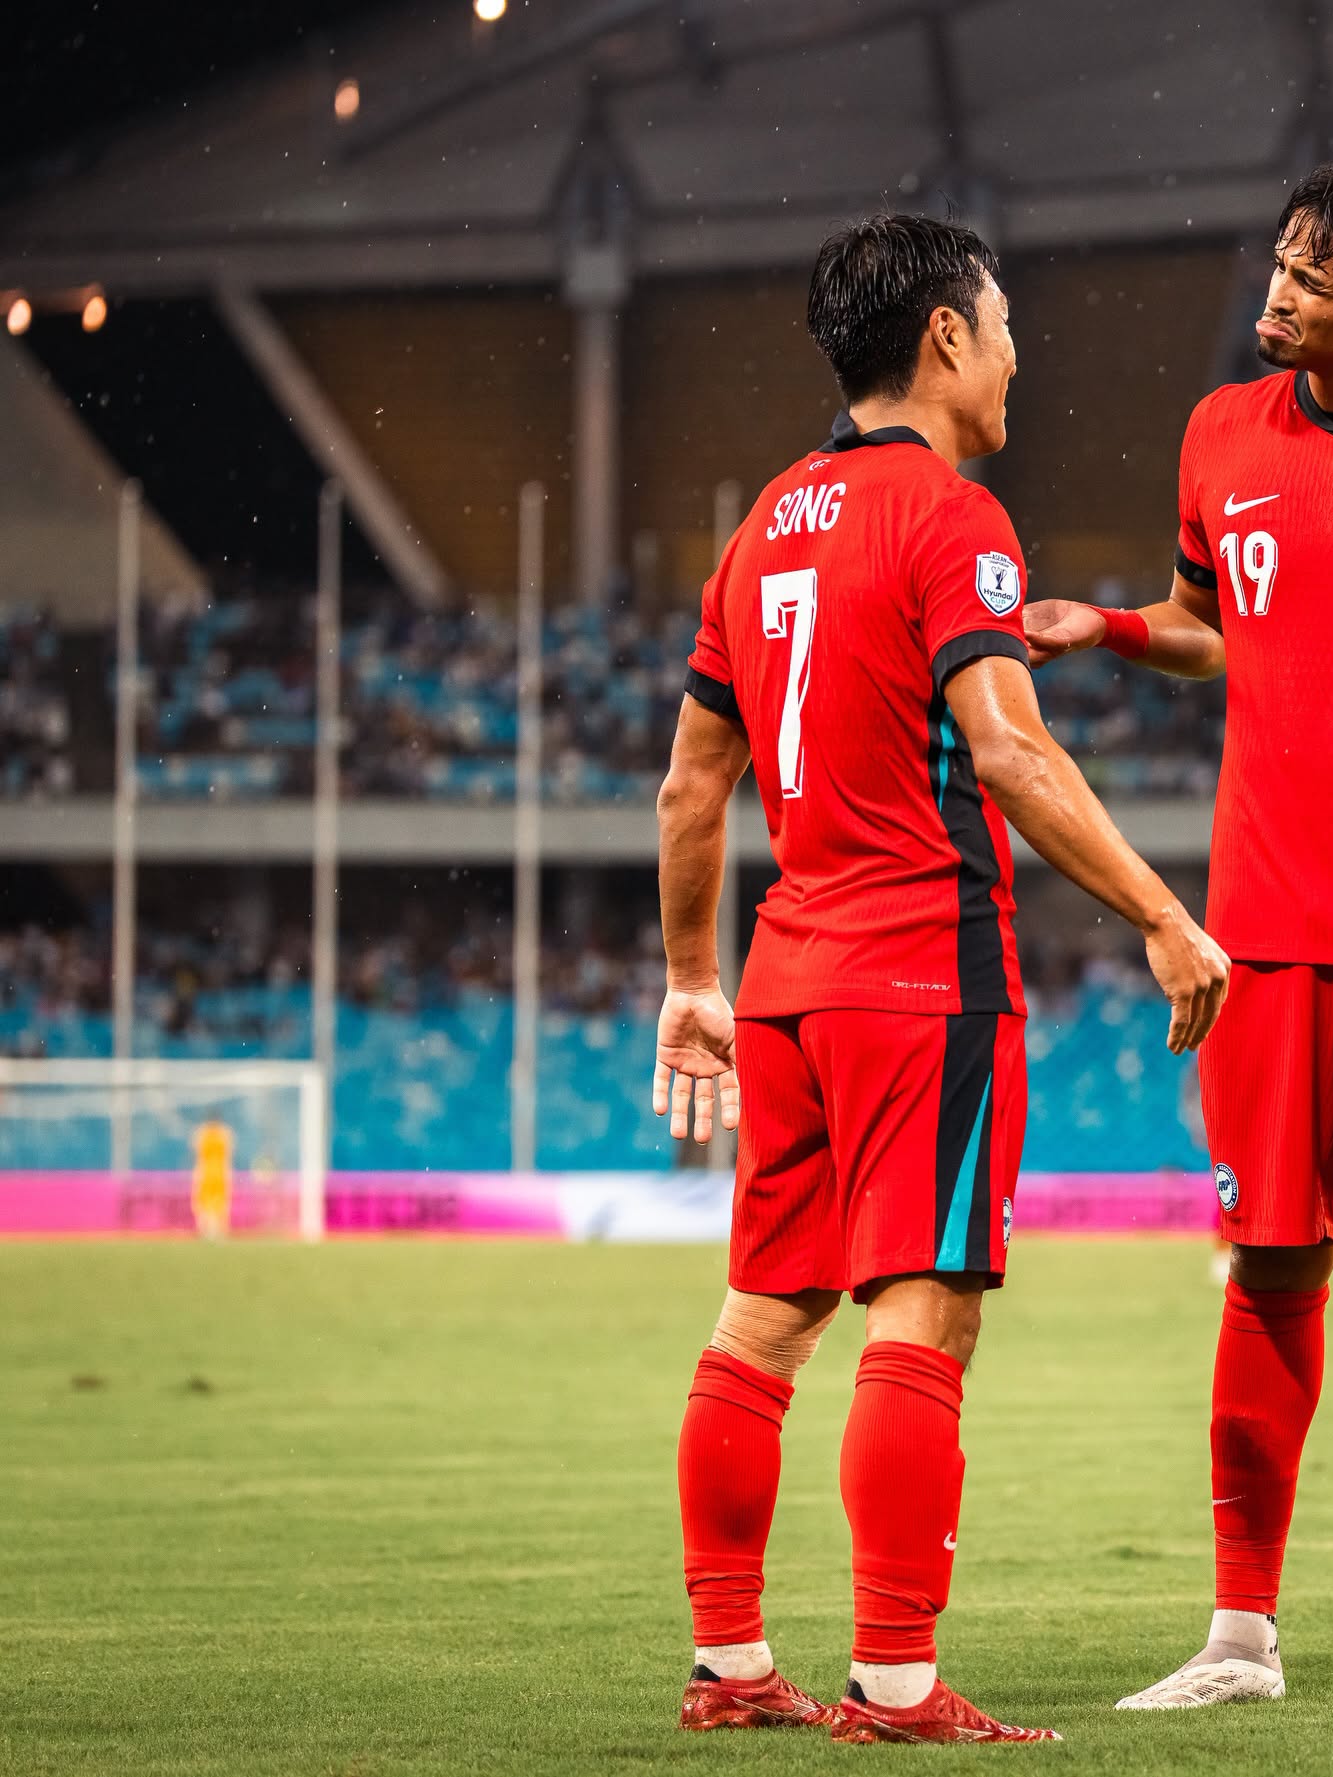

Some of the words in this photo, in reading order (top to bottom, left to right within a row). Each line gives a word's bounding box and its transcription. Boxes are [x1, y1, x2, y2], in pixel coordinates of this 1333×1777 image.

[766, 482, 847, 541] SONG
[983, 588, 1013, 601] Hyundai
[990, 597, 1006, 605] CUP
[1219, 530, 1279, 617] 19
[760, 567, 818, 799] 7
